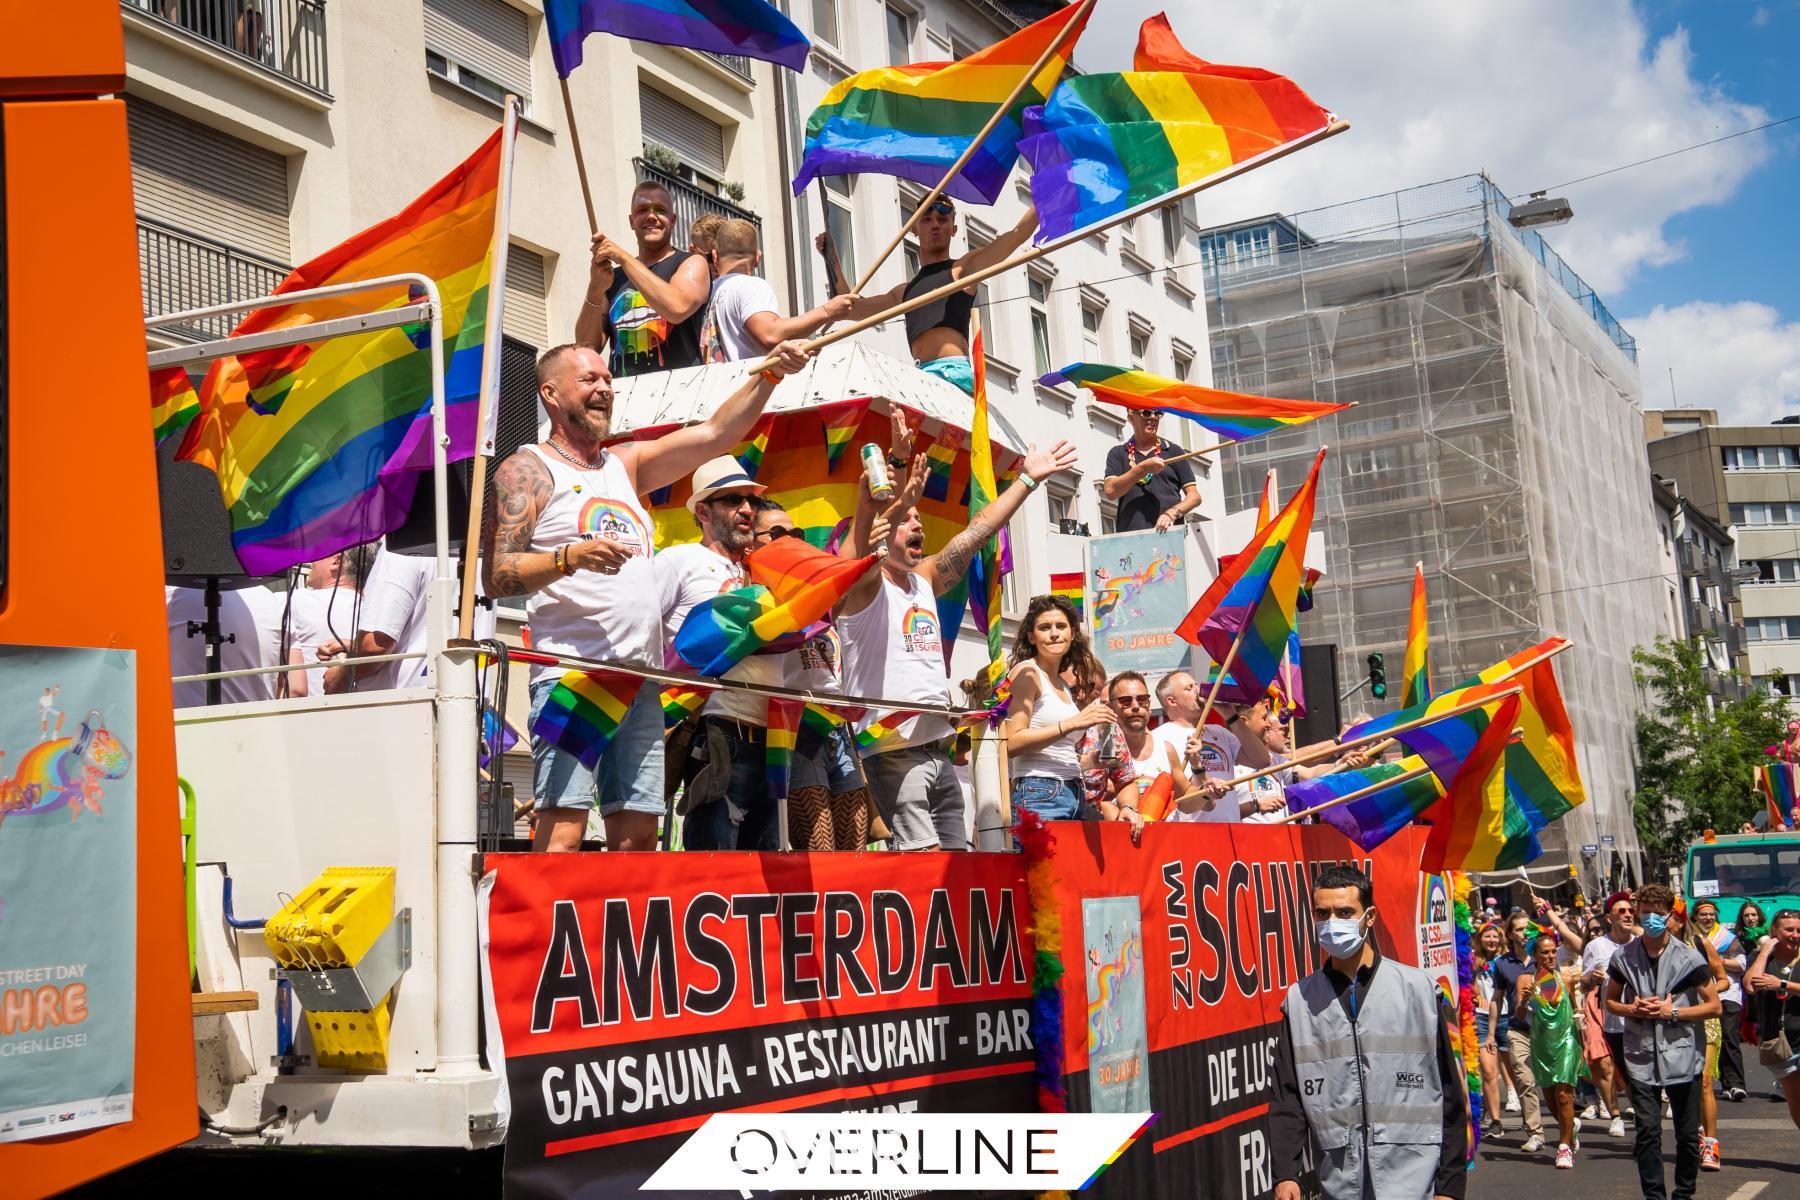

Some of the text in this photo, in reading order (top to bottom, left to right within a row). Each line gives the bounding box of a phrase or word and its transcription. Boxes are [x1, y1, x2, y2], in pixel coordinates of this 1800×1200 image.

[1108, 632, 1175, 651] 30 JAHRE
[1704, 885, 1716, 895] 32
[1162, 859, 1373, 1010] ZUM SCHW
[56, 964, 87, 980] DAY
[530, 888, 1026, 1034] AMSTERDAM
[0, 983, 88, 1036] HRE
[0, 1033, 87, 1056] CHEN LEISE!
[542, 1044, 741, 1124] GAYSAUNA
[765, 1016, 949, 1087] RESTAURANT
[976, 1009, 1034, 1055] BAR
[1207, 1036, 1279, 1106] DIE LUS
[1396, 1072, 1424, 1083] WGG
[1304, 1077, 1325, 1096] 87
